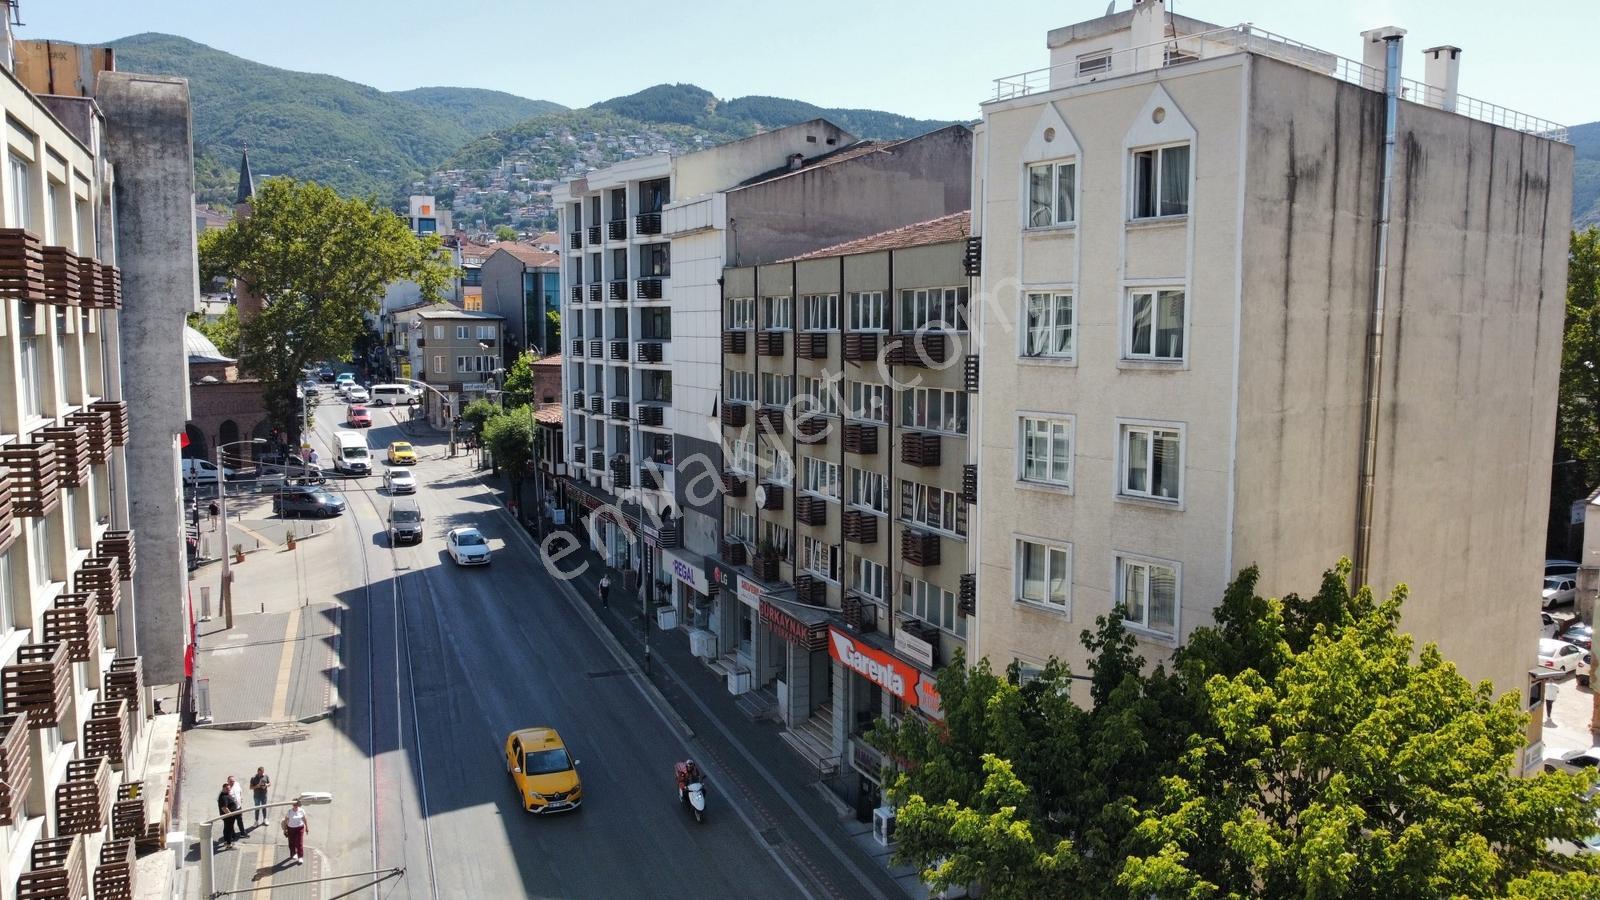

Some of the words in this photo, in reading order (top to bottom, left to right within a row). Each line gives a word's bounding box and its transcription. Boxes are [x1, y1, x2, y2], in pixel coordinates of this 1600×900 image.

[674, 560, 695, 585] REGAL
[720, 571, 728, 585] LG
[847, 644, 905, 698] Garenta
